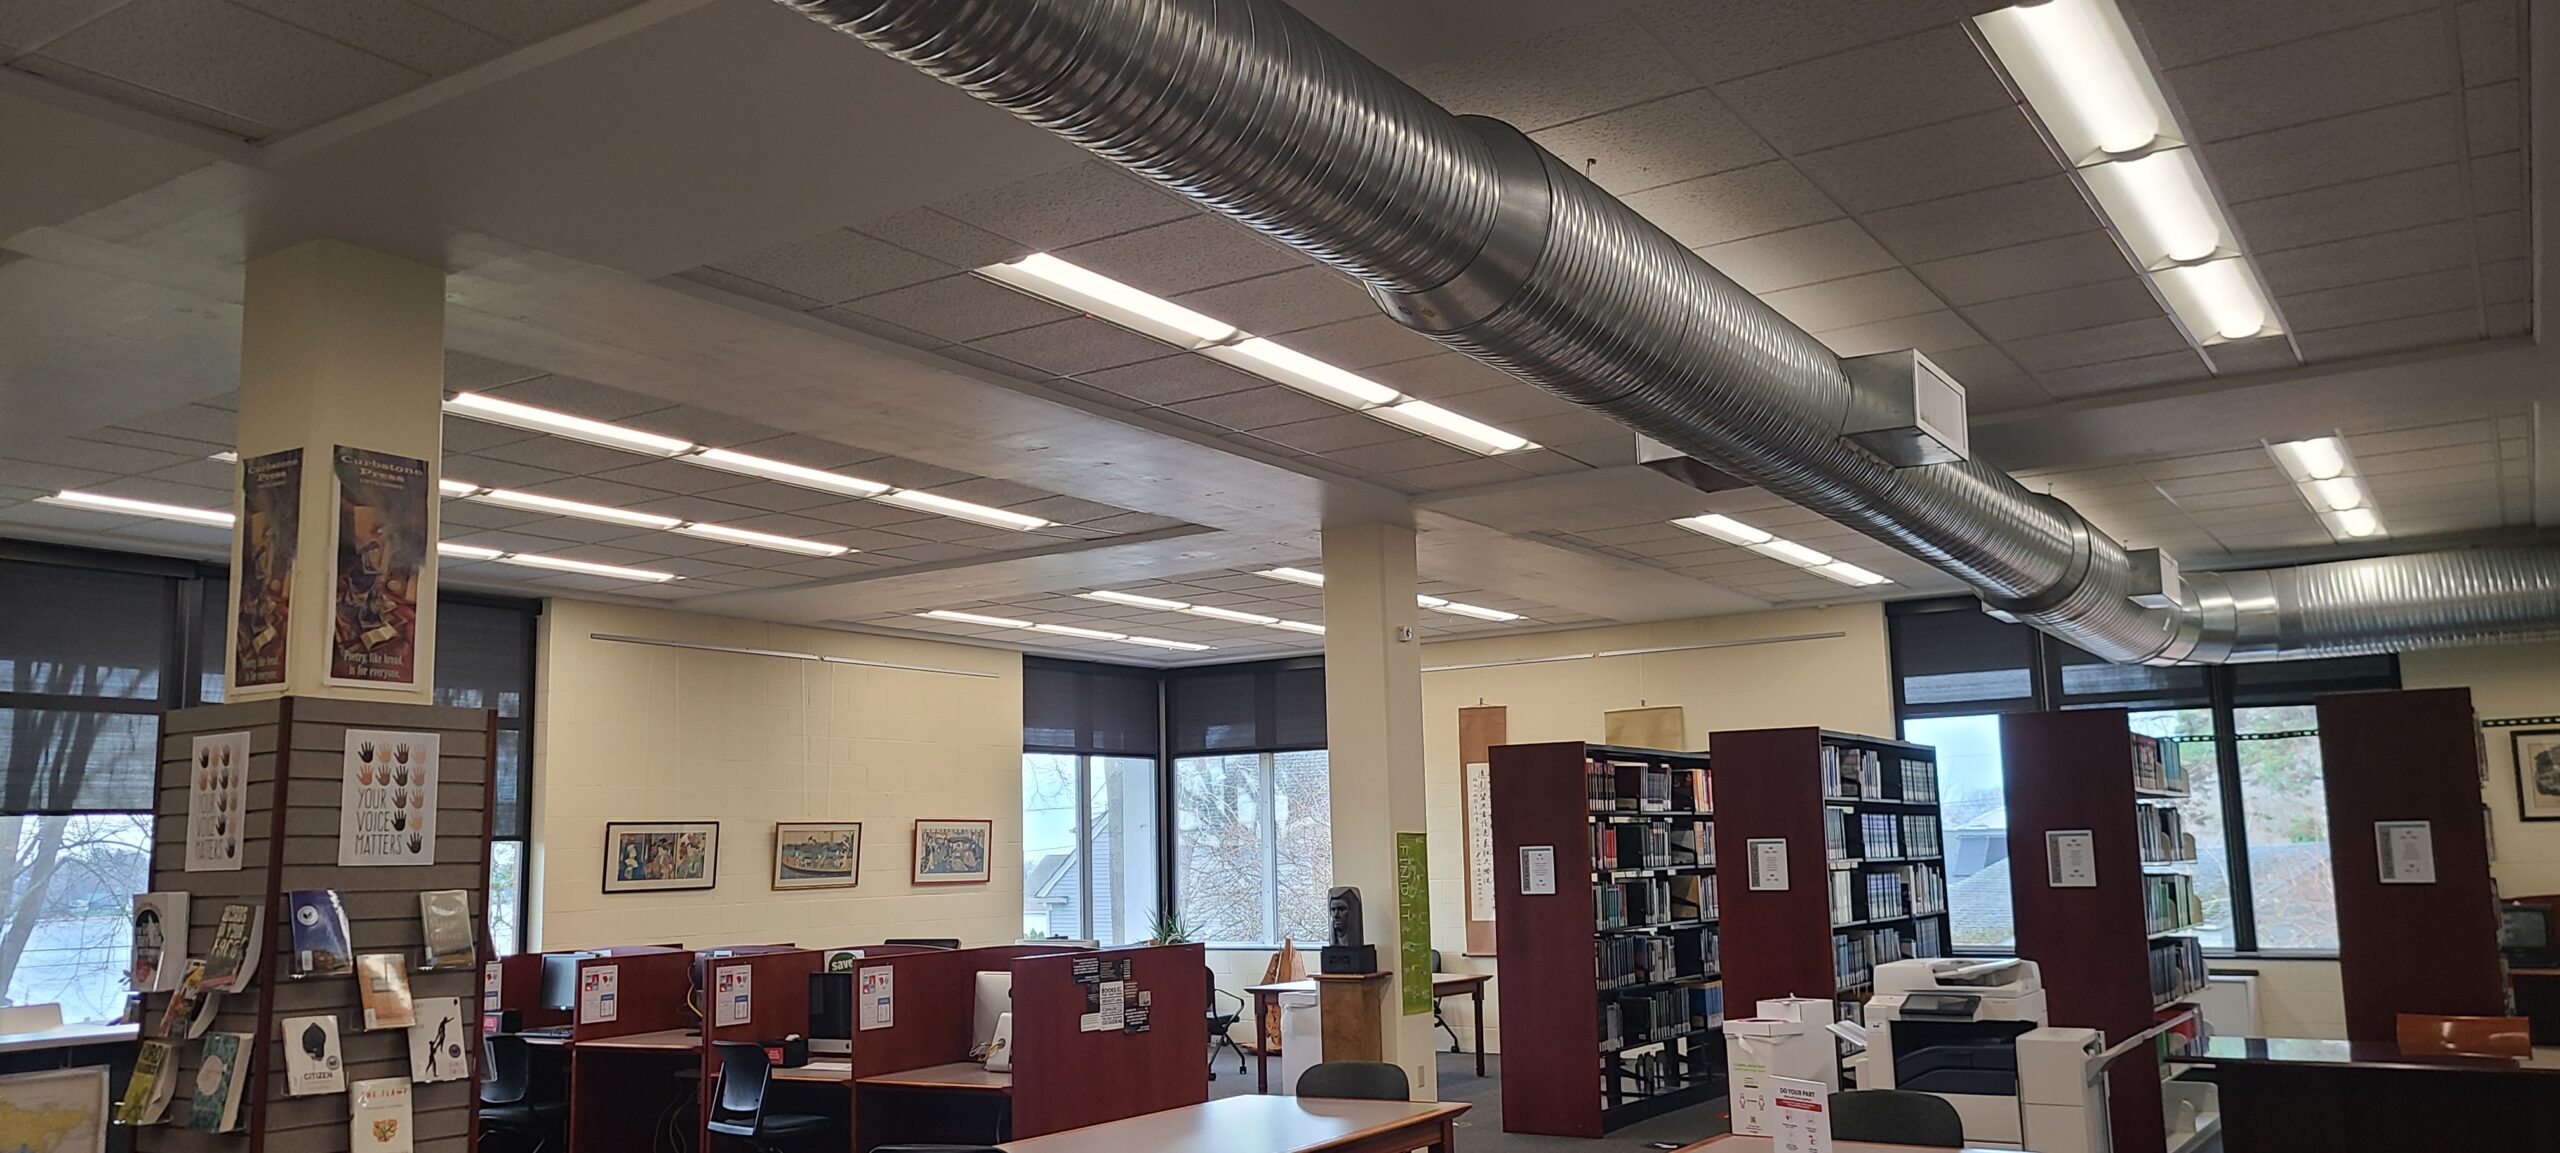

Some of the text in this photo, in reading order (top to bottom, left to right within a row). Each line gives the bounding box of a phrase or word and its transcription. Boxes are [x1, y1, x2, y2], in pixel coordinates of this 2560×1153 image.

[340, 454, 423, 477] Curbstone
[359, 467, 405, 483] Press
[369, 652, 382, 664] like
[357, 664, 368, 676] for
[358, 788, 387, 810] YOUR
[356, 810, 390, 832] VOICE
[354, 833, 403, 856] MATTERS
[1399, 844, 1411, 921] FIND IT
[303, 1071, 334, 1081] CITIZEN
[1779, 1087, 1788, 1095] DO
[1802, 1090, 1815, 1098] PART
